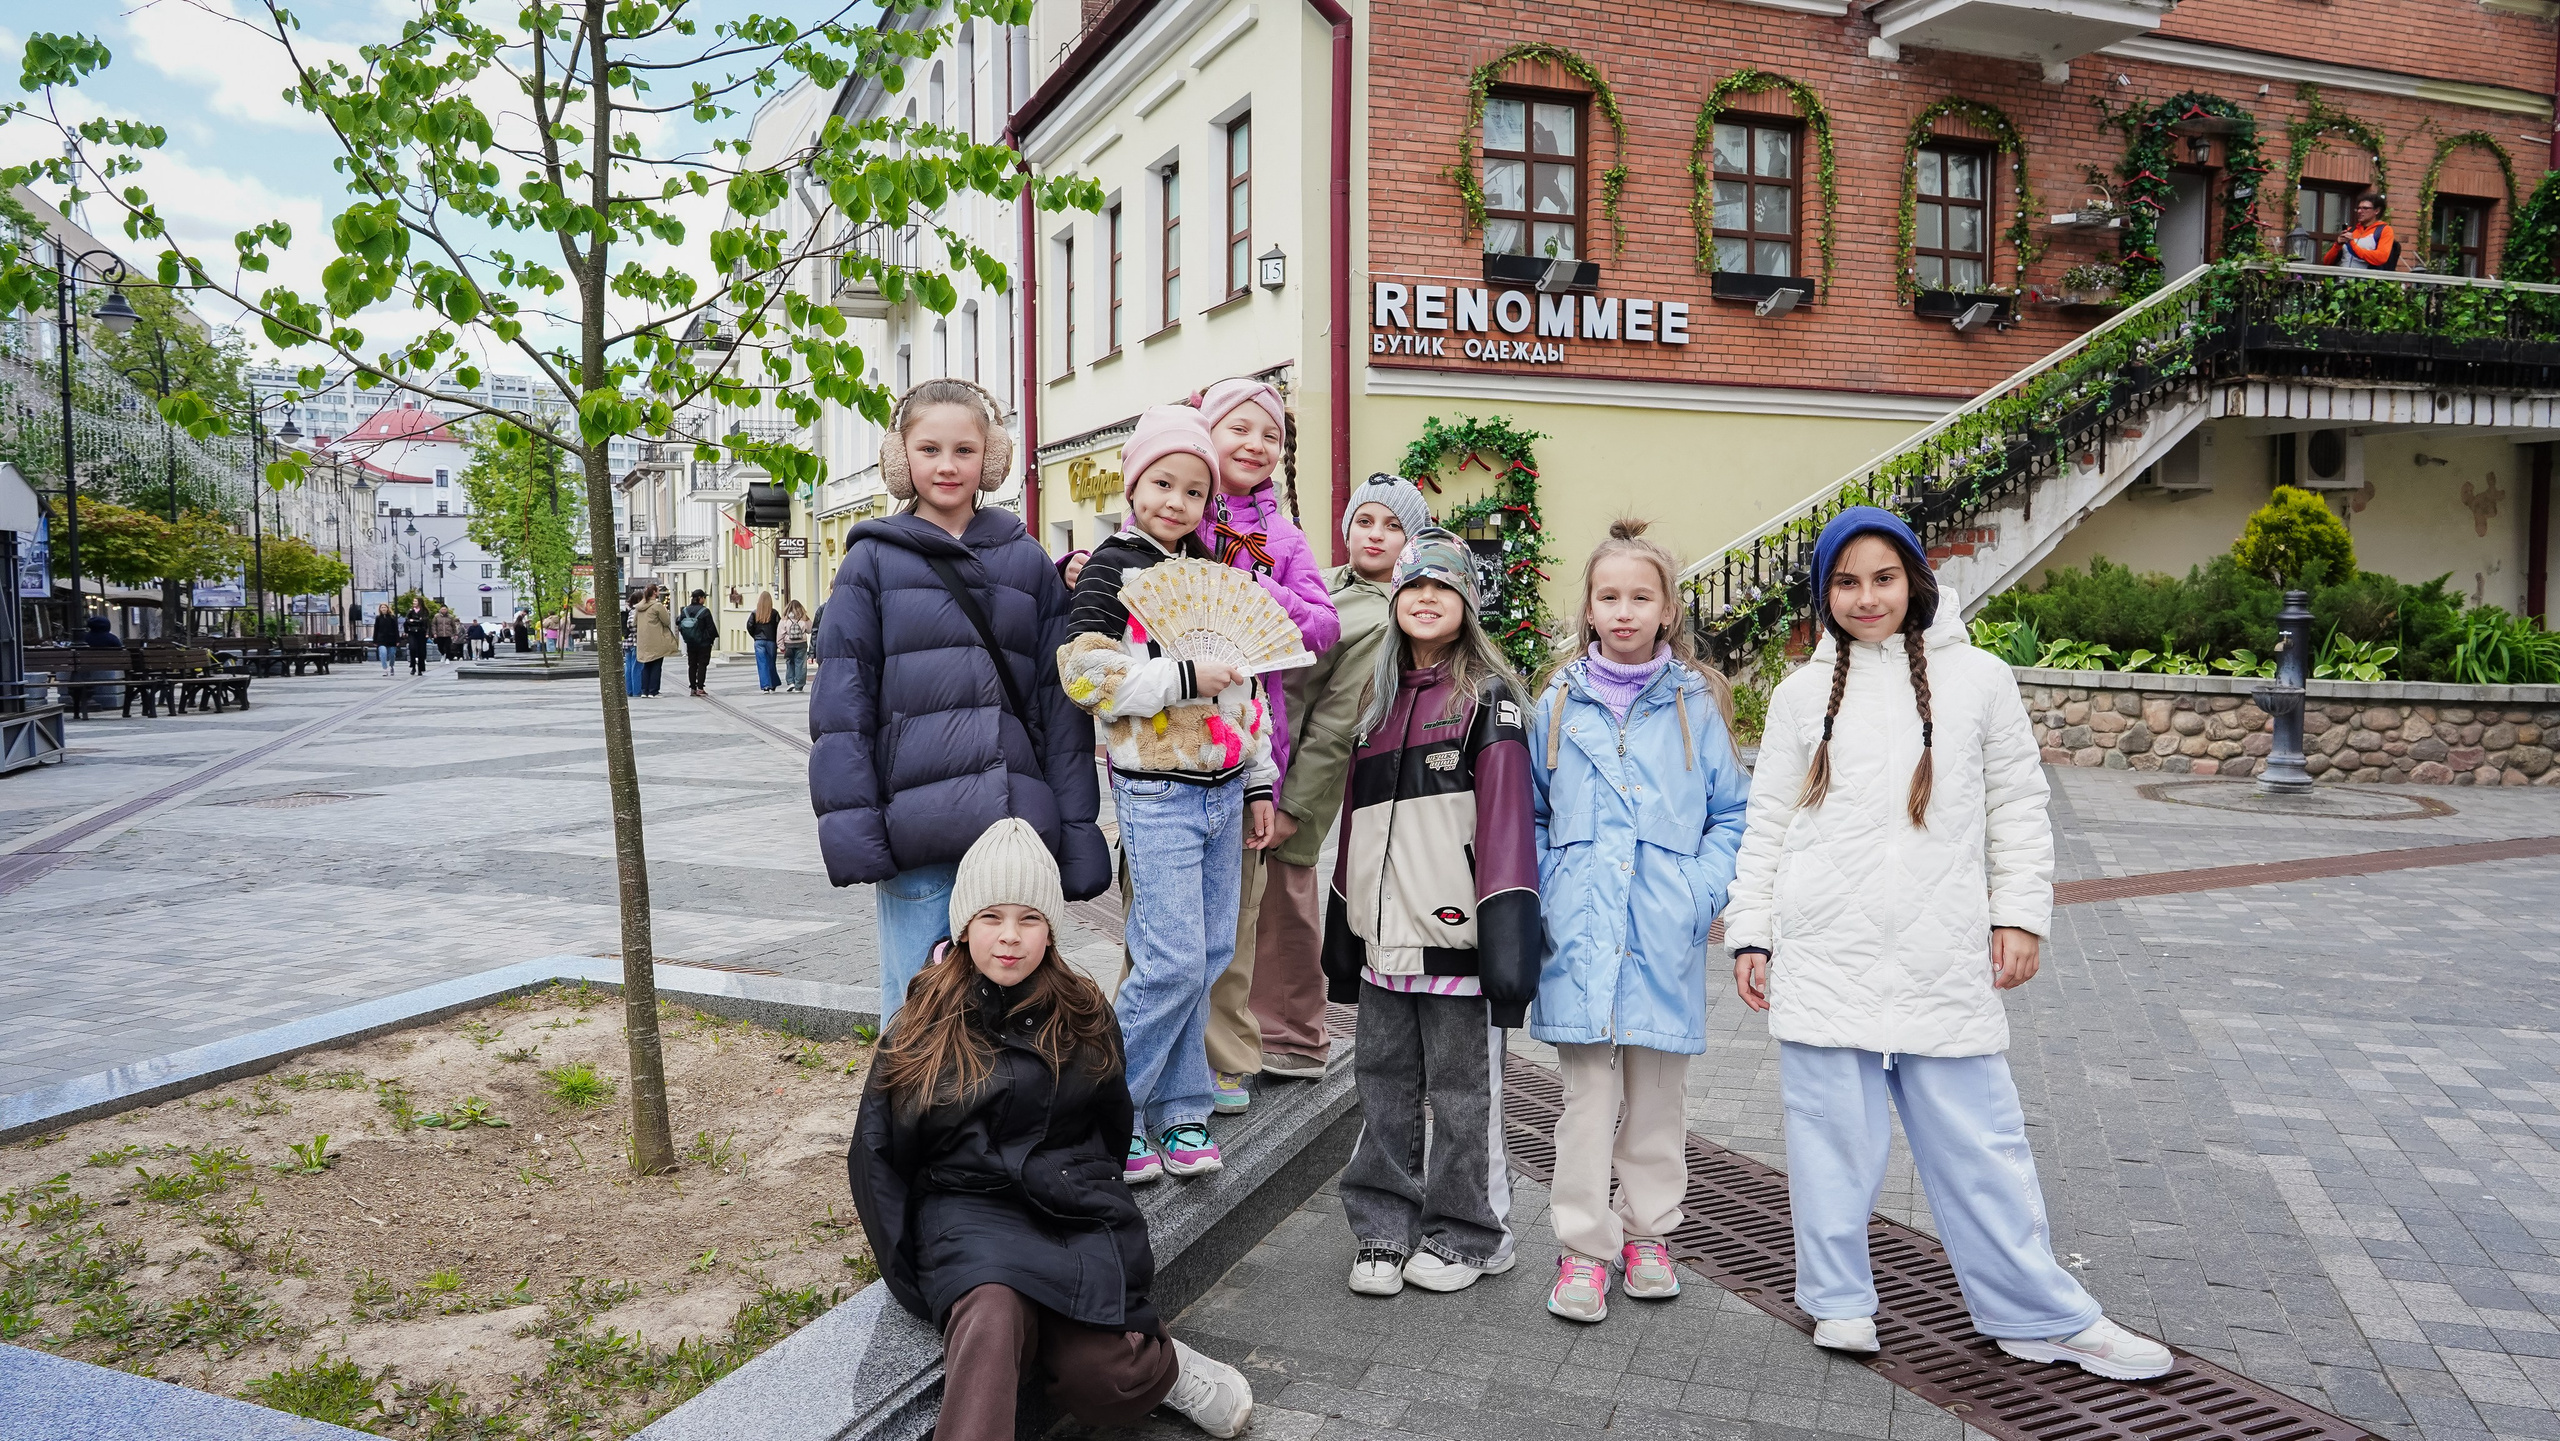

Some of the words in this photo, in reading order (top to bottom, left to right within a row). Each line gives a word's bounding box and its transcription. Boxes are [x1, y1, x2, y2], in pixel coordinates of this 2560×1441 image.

[1264, 262, 1281, 280] 15
[1374, 281, 1690, 345] RENOMMEE
[1373, 334, 1446, 356] БУТИК
[1464, 338, 1565, 364] ОДЕЖДЫ
[778, 538, 805, 547] ZIKO
